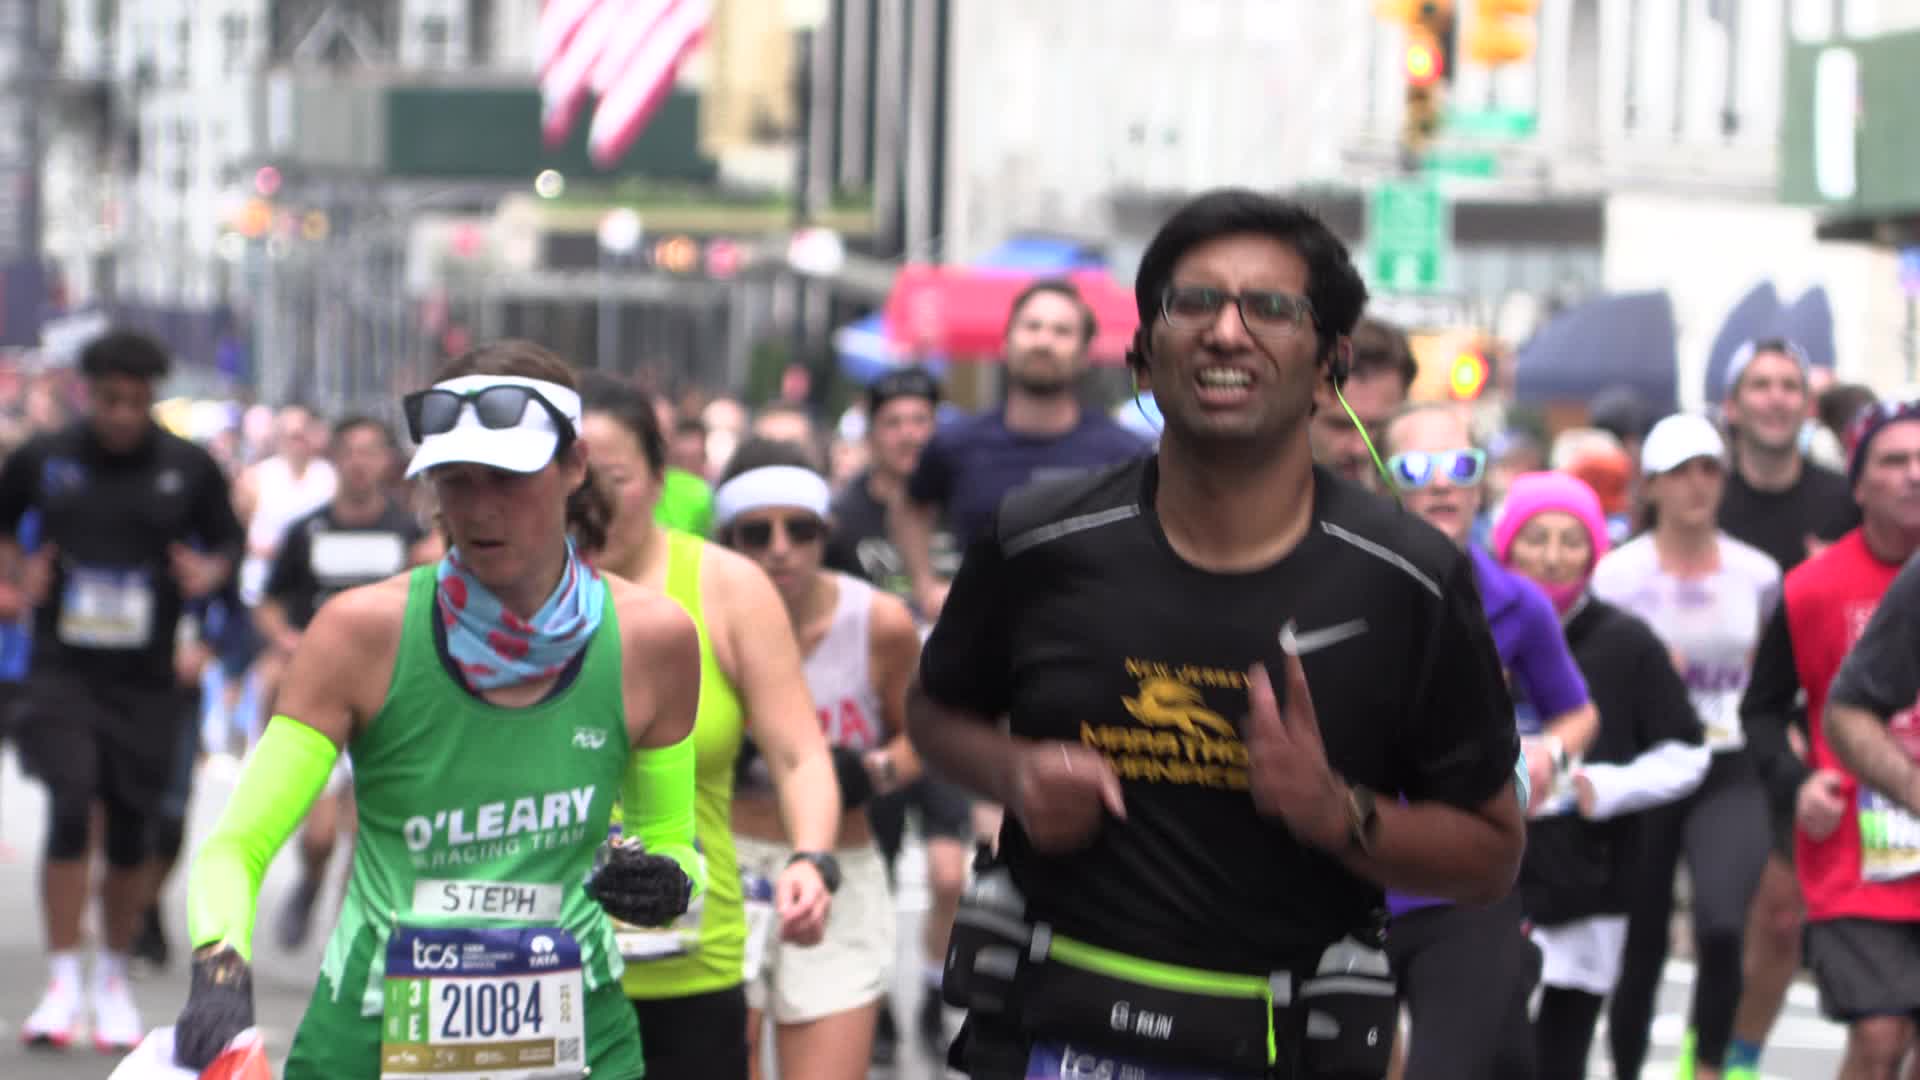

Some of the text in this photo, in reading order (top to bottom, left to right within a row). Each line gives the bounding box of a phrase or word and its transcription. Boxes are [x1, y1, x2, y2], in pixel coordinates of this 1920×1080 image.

[1125, 656, 1168, 679] NEW
[1080, 720, 1249, 768] MARATHO
[403, 785, 595, 851] O'LEARY
[432, 826, 585, 866] RACING TEAM
[442, 883, 536, 914] STEPH
[412, 936, 459, 969] tcs
[529, 954, 560, 967] TATA
[441, 980, 543, 1039] 21084
